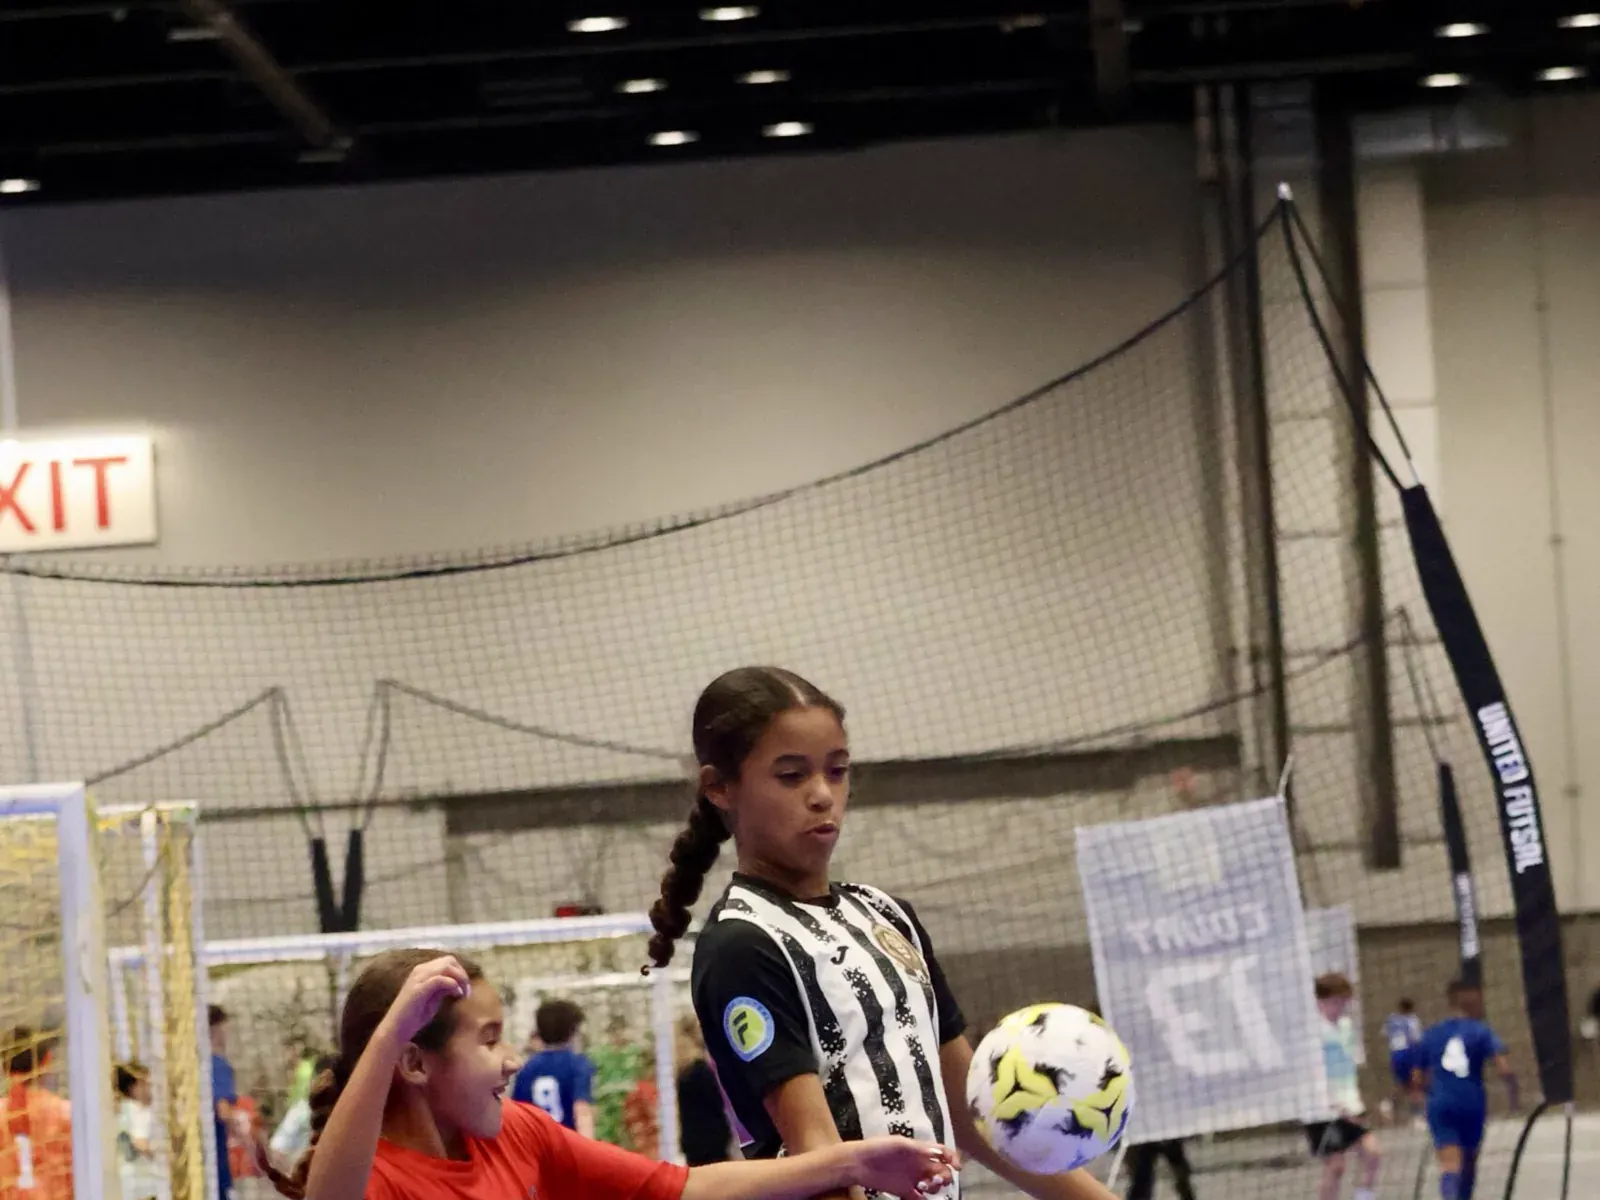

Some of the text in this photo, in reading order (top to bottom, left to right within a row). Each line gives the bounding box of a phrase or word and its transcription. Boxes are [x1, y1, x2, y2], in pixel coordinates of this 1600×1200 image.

[1477, 702, 1545, 875] UNITED FUTSAL
[1441, 1035, 1470, 1079] 4
[531, 1075, 564, 1123] 9
[15, 1133, 36, 1189] 1
